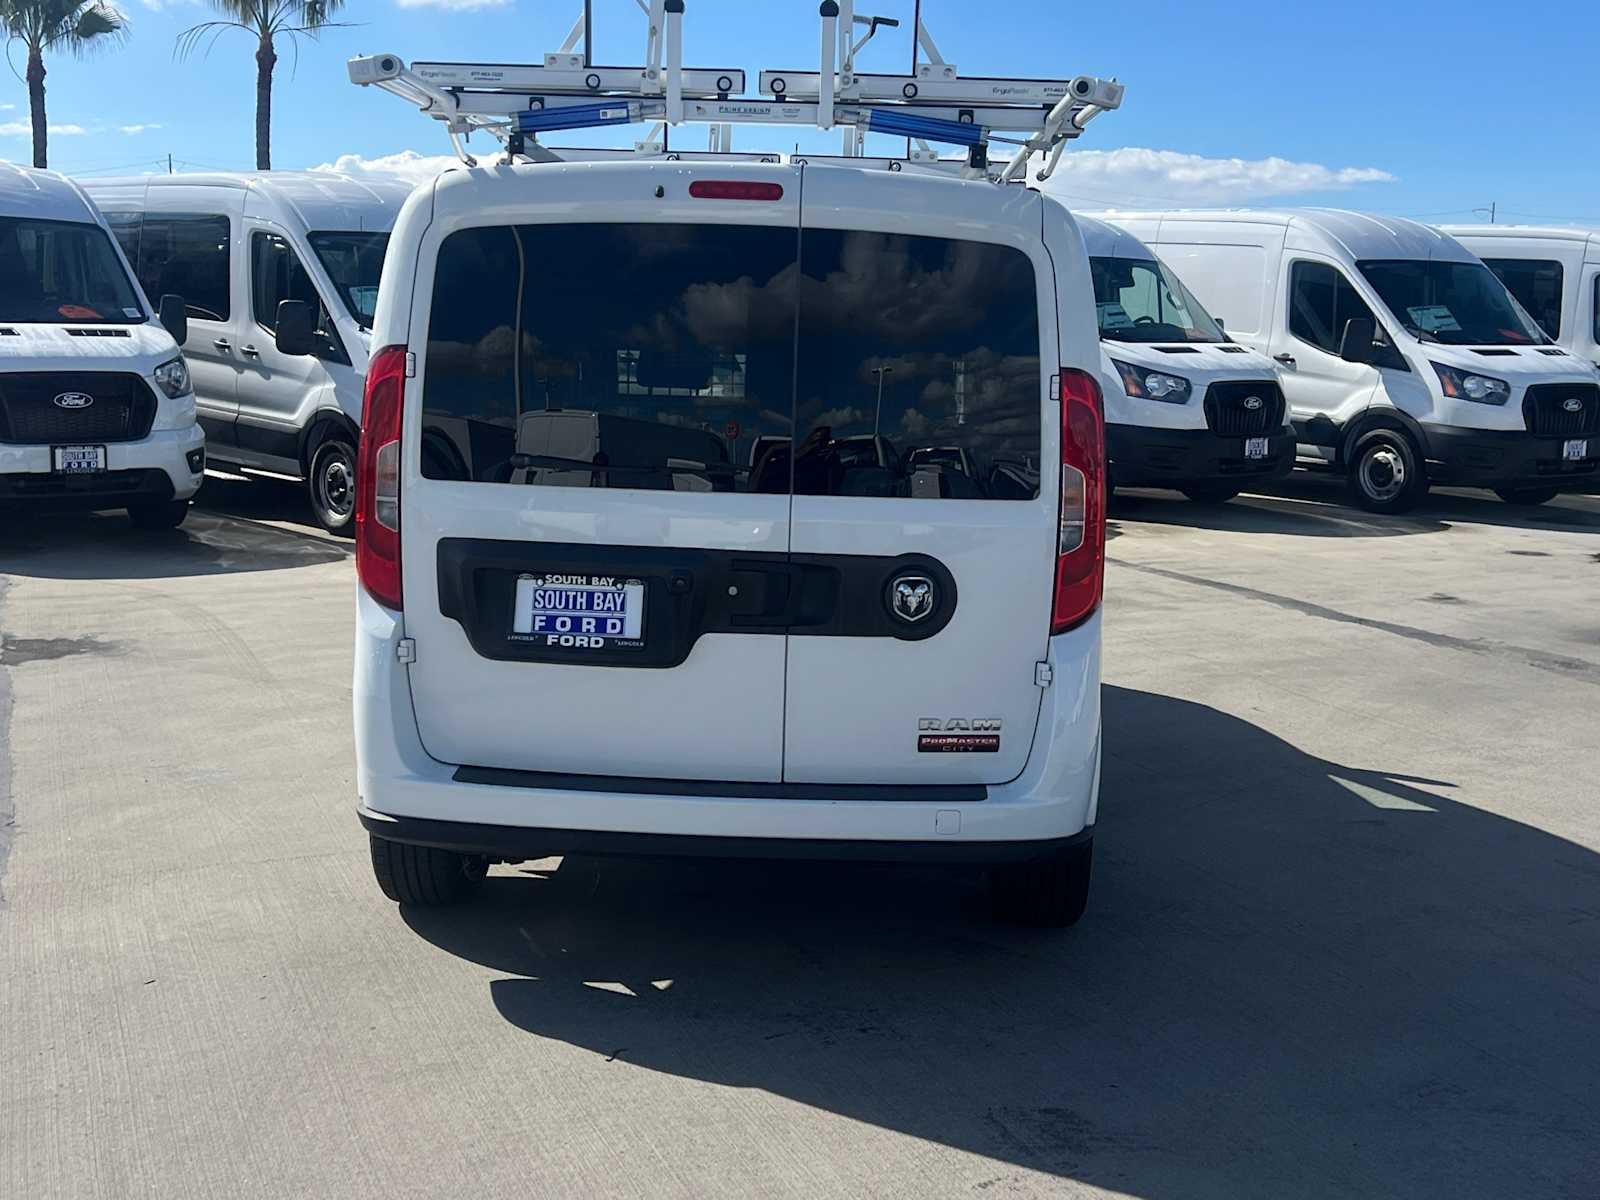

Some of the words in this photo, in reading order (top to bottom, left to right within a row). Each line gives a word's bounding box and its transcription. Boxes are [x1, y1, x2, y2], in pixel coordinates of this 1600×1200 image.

[545, 574, 587, 585] SOUTH
[591, 576, 615, 587] BAY
[535, 590, 587, 610] SOUTH
[593, 592, 625, 611] BAY
[534, 615, 622, 634] FORD
[546, 634, 604, 648] FORD
[918, 718, 1001, 731] RAM
